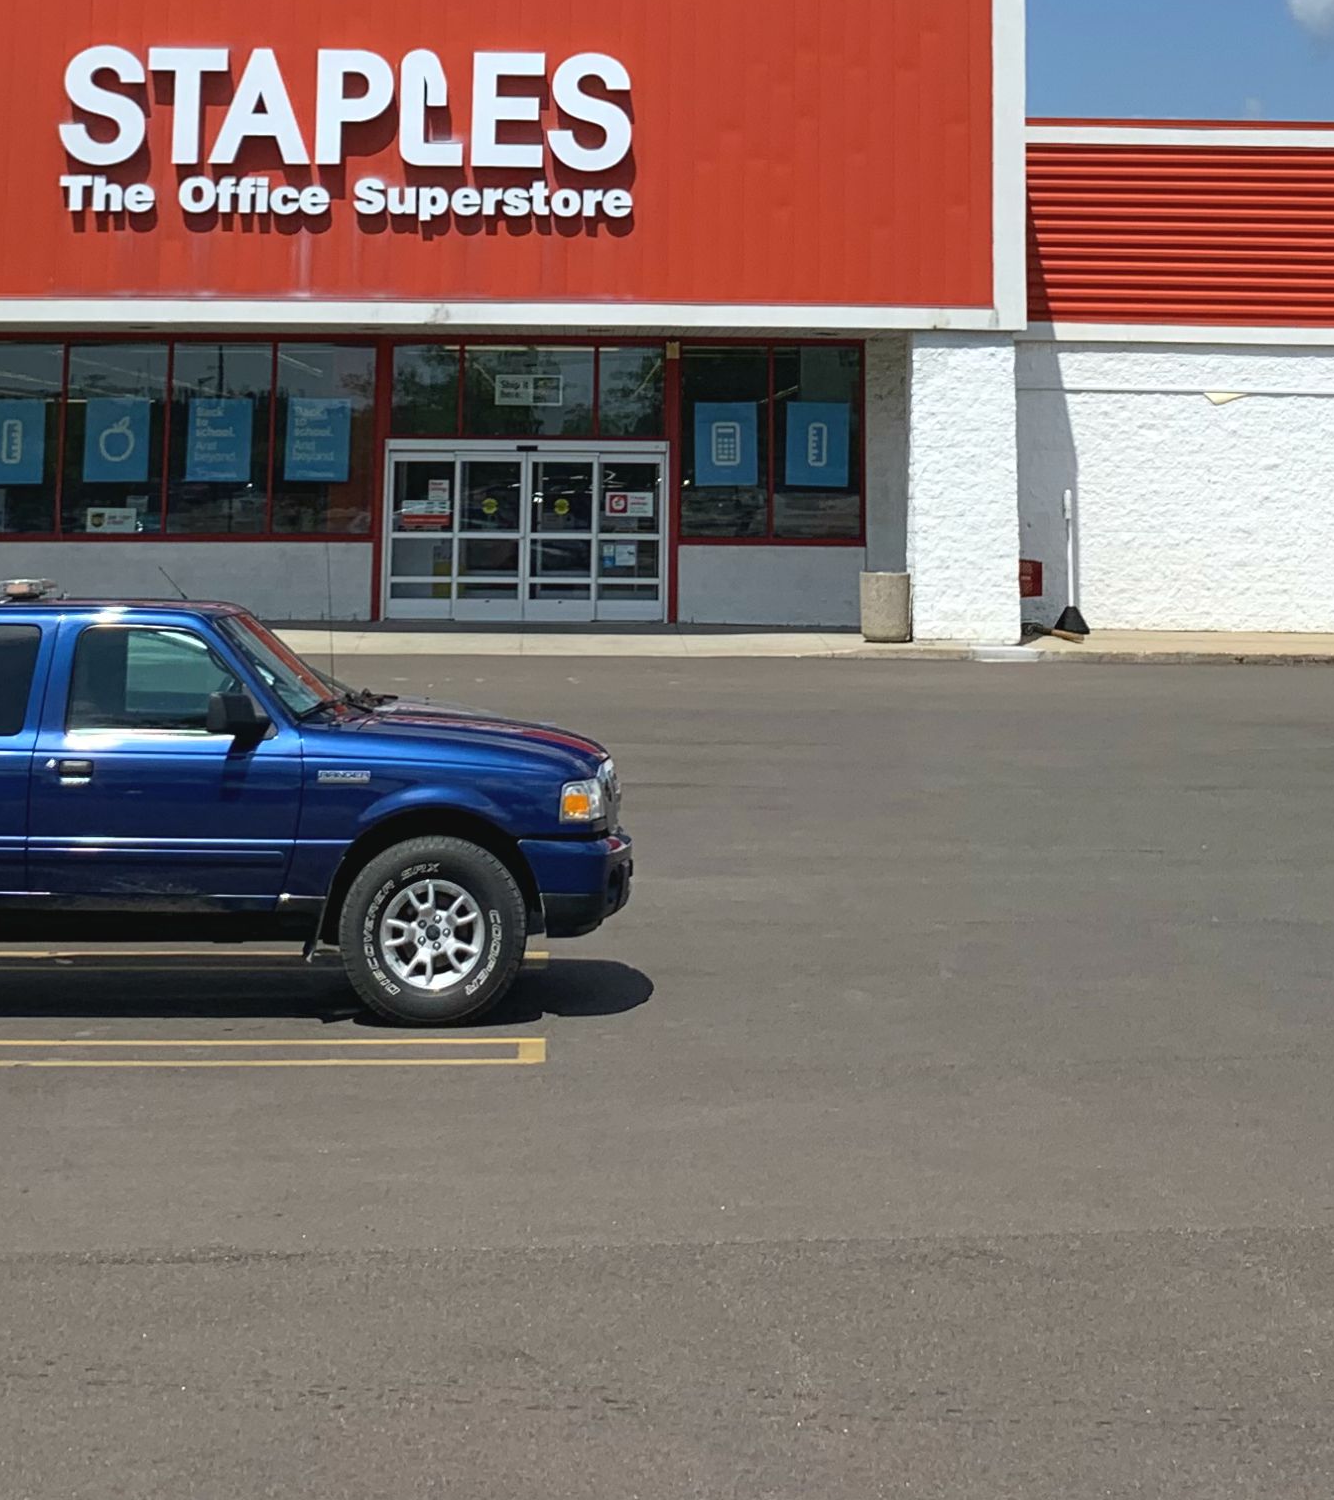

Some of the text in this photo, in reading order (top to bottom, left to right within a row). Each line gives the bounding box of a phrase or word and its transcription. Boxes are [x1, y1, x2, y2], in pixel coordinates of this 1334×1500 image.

[58, 45, 633, 172] STAPLES
[60, 175, 633, 222] The Office Superstore
[464, 909, 503, 996] COOPER
